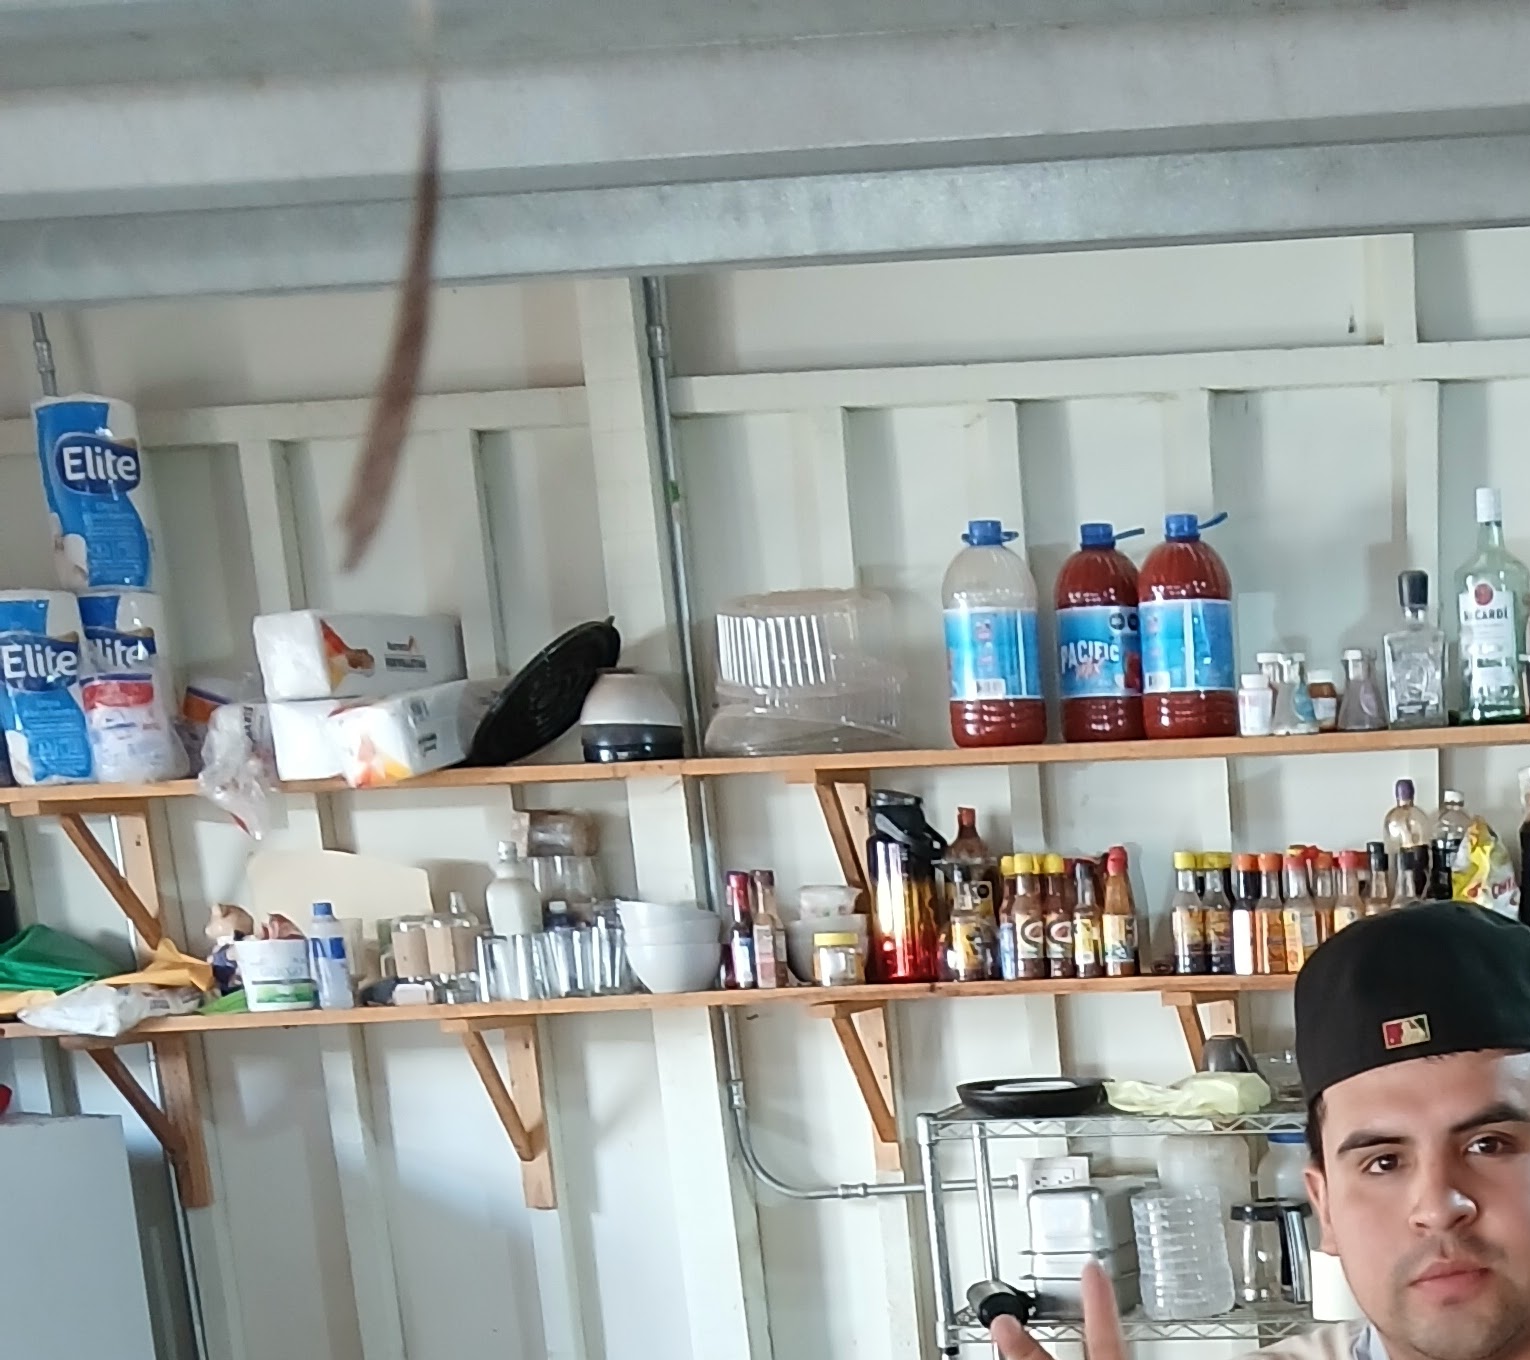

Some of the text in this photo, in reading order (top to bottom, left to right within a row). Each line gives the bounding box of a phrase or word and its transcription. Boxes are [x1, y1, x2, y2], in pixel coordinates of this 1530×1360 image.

[62, 446, 138, 481] Elite
[1464, 606, 1508, 620] BCARDÍ
[2, 643, 78, 679] Elite
[91, 637, 148, 669] lite
[1060, 639, 1120, 675] PACIFIC
